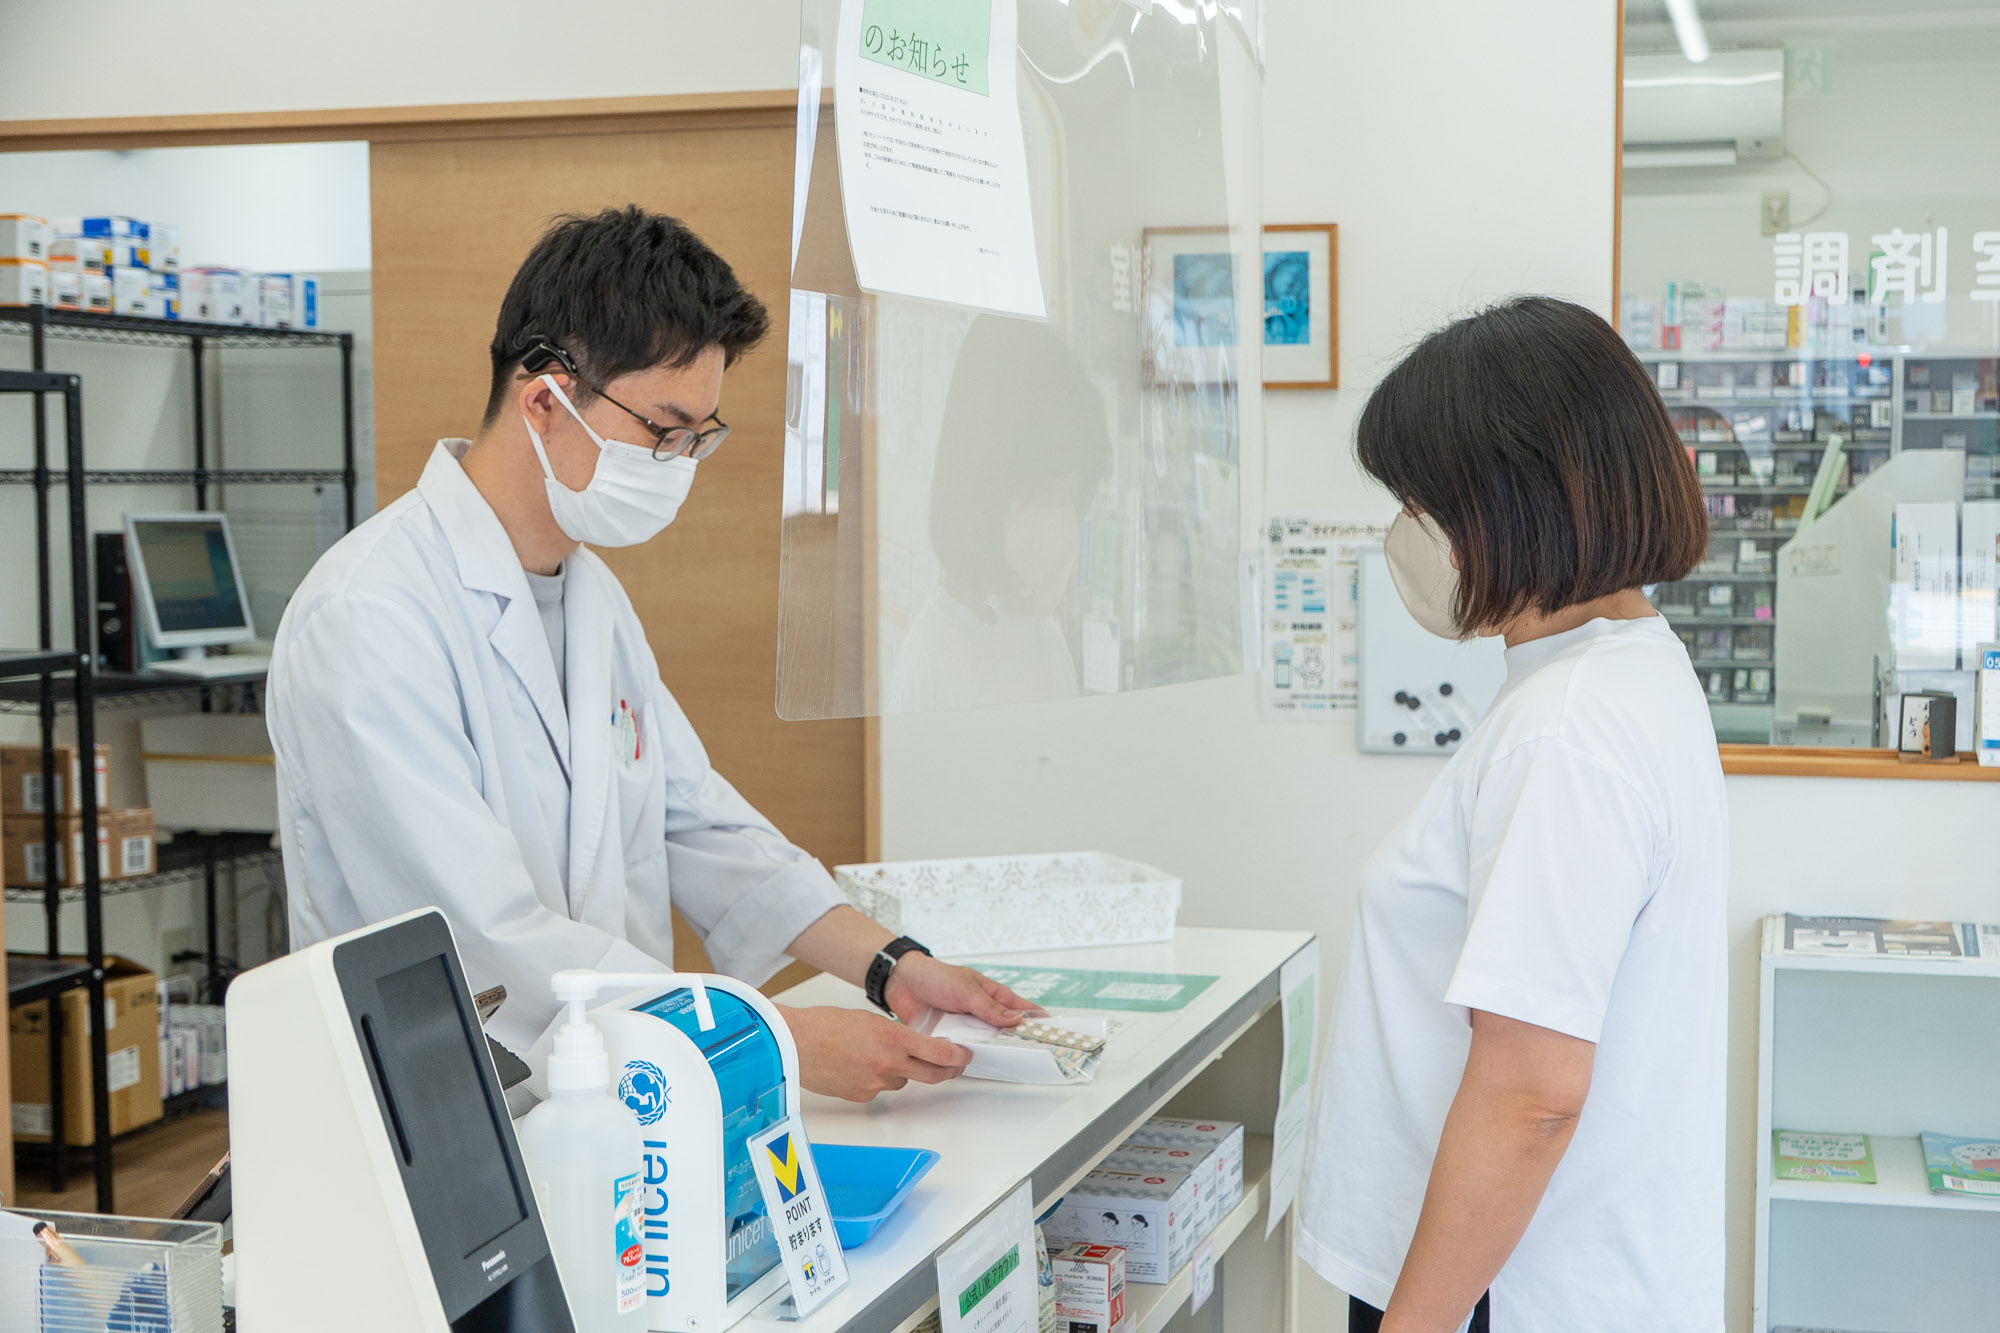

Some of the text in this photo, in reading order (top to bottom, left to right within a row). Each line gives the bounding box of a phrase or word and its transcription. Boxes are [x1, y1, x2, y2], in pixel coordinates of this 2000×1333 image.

[865, 24, 970, 85] のお知らせ
[785, 1196, 812, 1225] POINT
[788, 1216, 822, 1251] 貯まります
